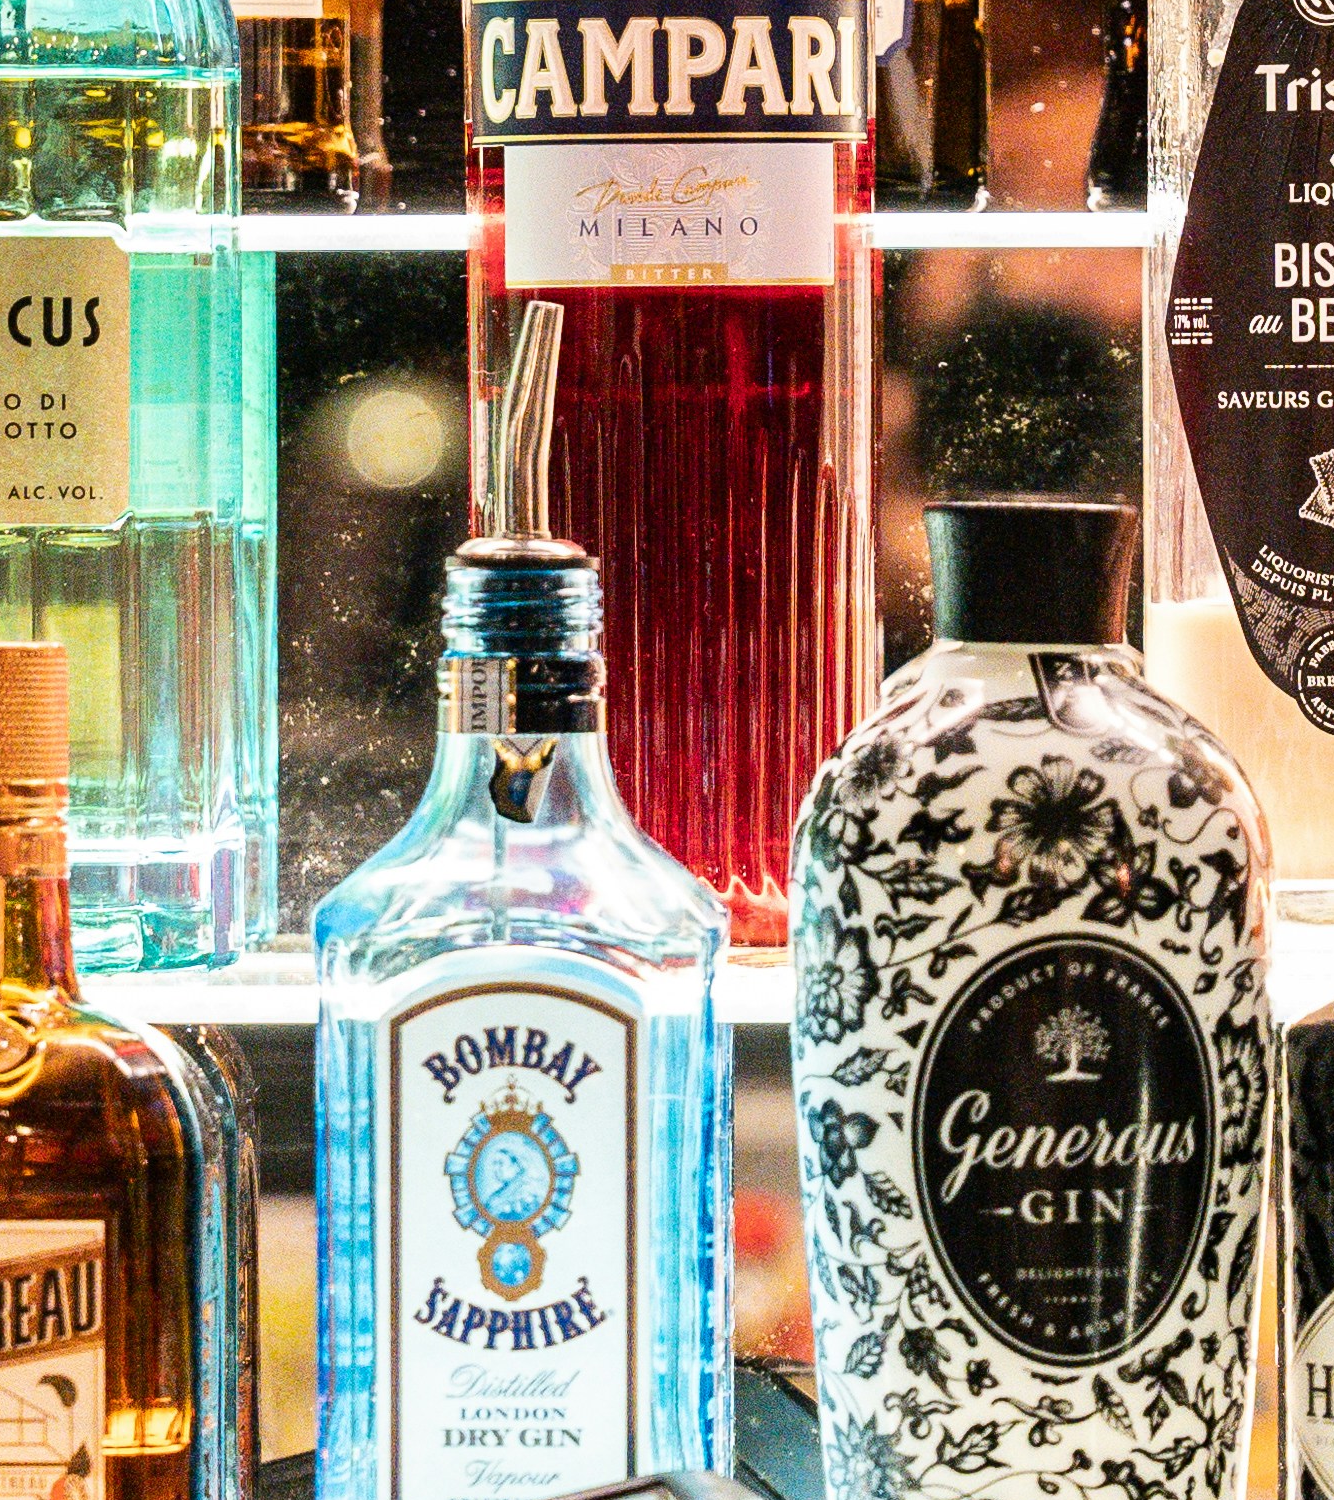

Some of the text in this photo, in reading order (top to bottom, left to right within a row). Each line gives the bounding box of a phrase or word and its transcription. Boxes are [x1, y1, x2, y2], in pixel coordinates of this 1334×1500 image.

[481, 15, 857, 124] CAMPARI
[578, 216, 761, 238] MILANO
[624, 267, 714, 281] BITTER
[1249, 313, 1284, 337] au
[40, 393, 68, 410] DI
[1217, 389, 1311, 410] SAVEURS
[1250, 558, 1307, 599] DEPUIS
[422, 1025, 604, 1105] BOMBAY
[938, 1089, 1197, 1207] Generous
[1018, 1188, 1126, 1226] GIN
[413, 1277, 609, 1352] SAPPHIRE
[444, 1362, 581, 1401] Distilled
[459, 1407, 568, 1420] LONDON
[441, 1429, 585, 1449] DRY GIN
[463, 1458, 562, 1491] Vapour
